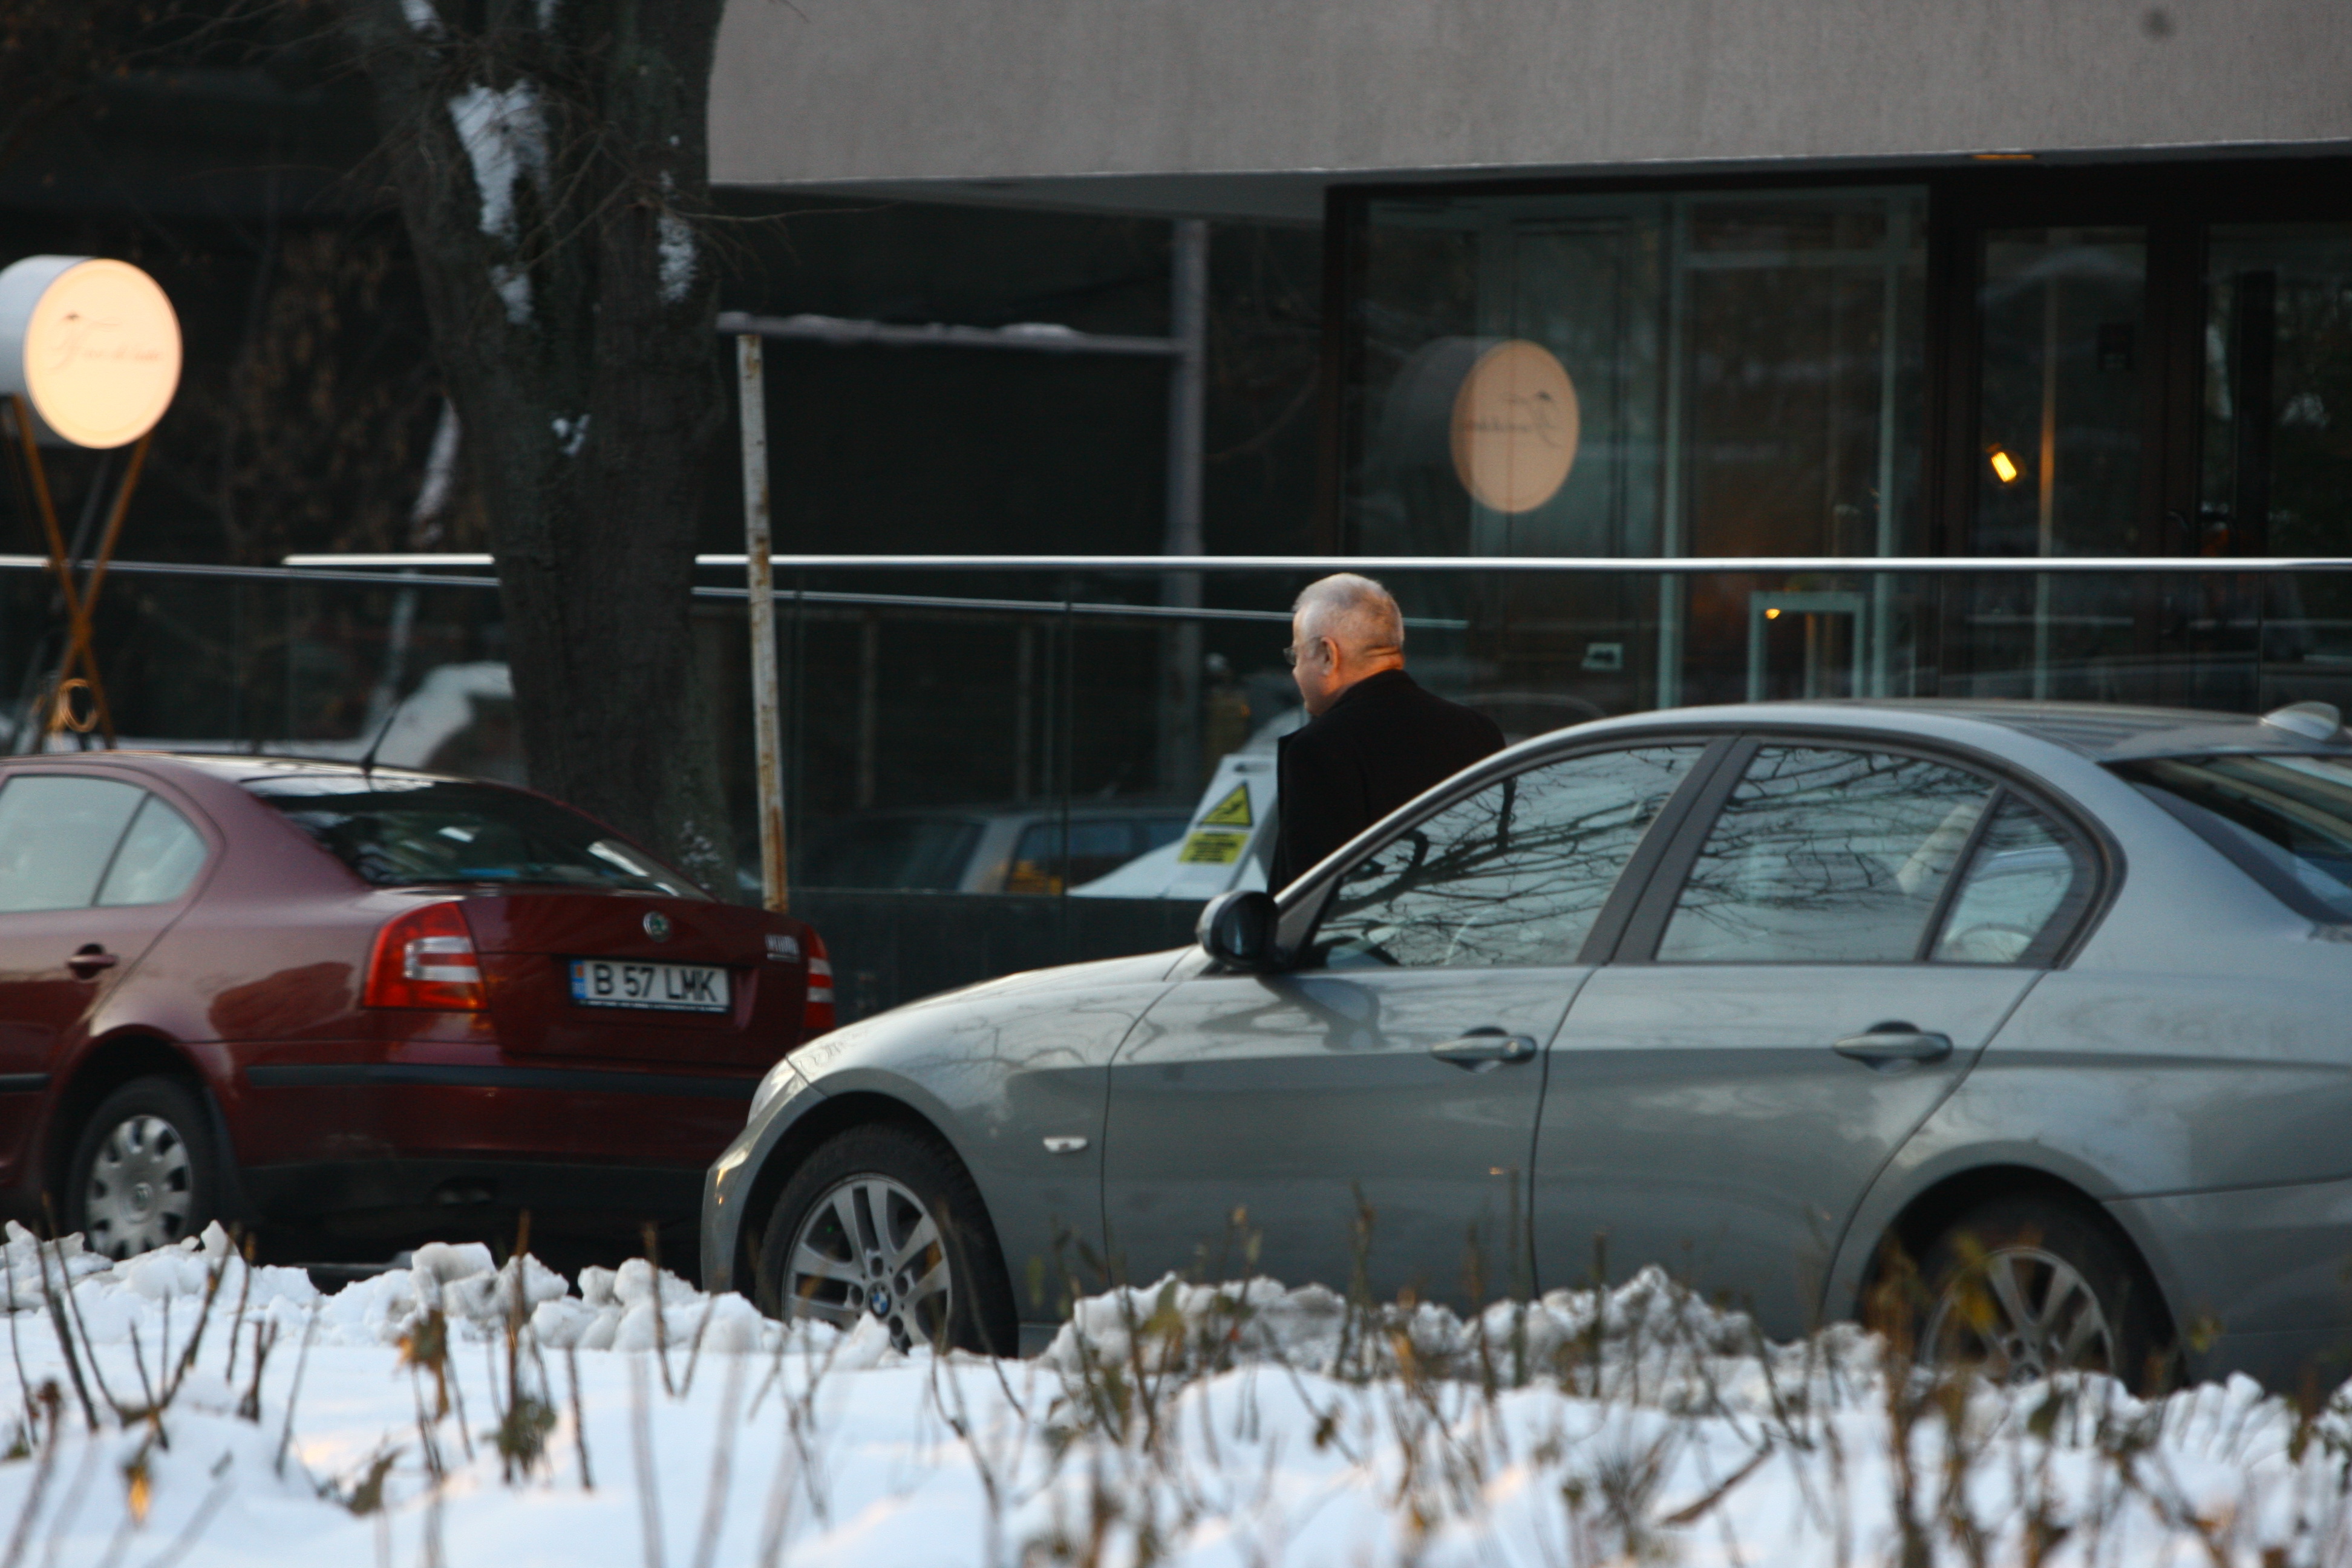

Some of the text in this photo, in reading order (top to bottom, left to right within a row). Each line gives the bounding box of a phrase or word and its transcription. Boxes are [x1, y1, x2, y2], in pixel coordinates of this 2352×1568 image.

[593, 964, 717, 1002] B 57 LMK
